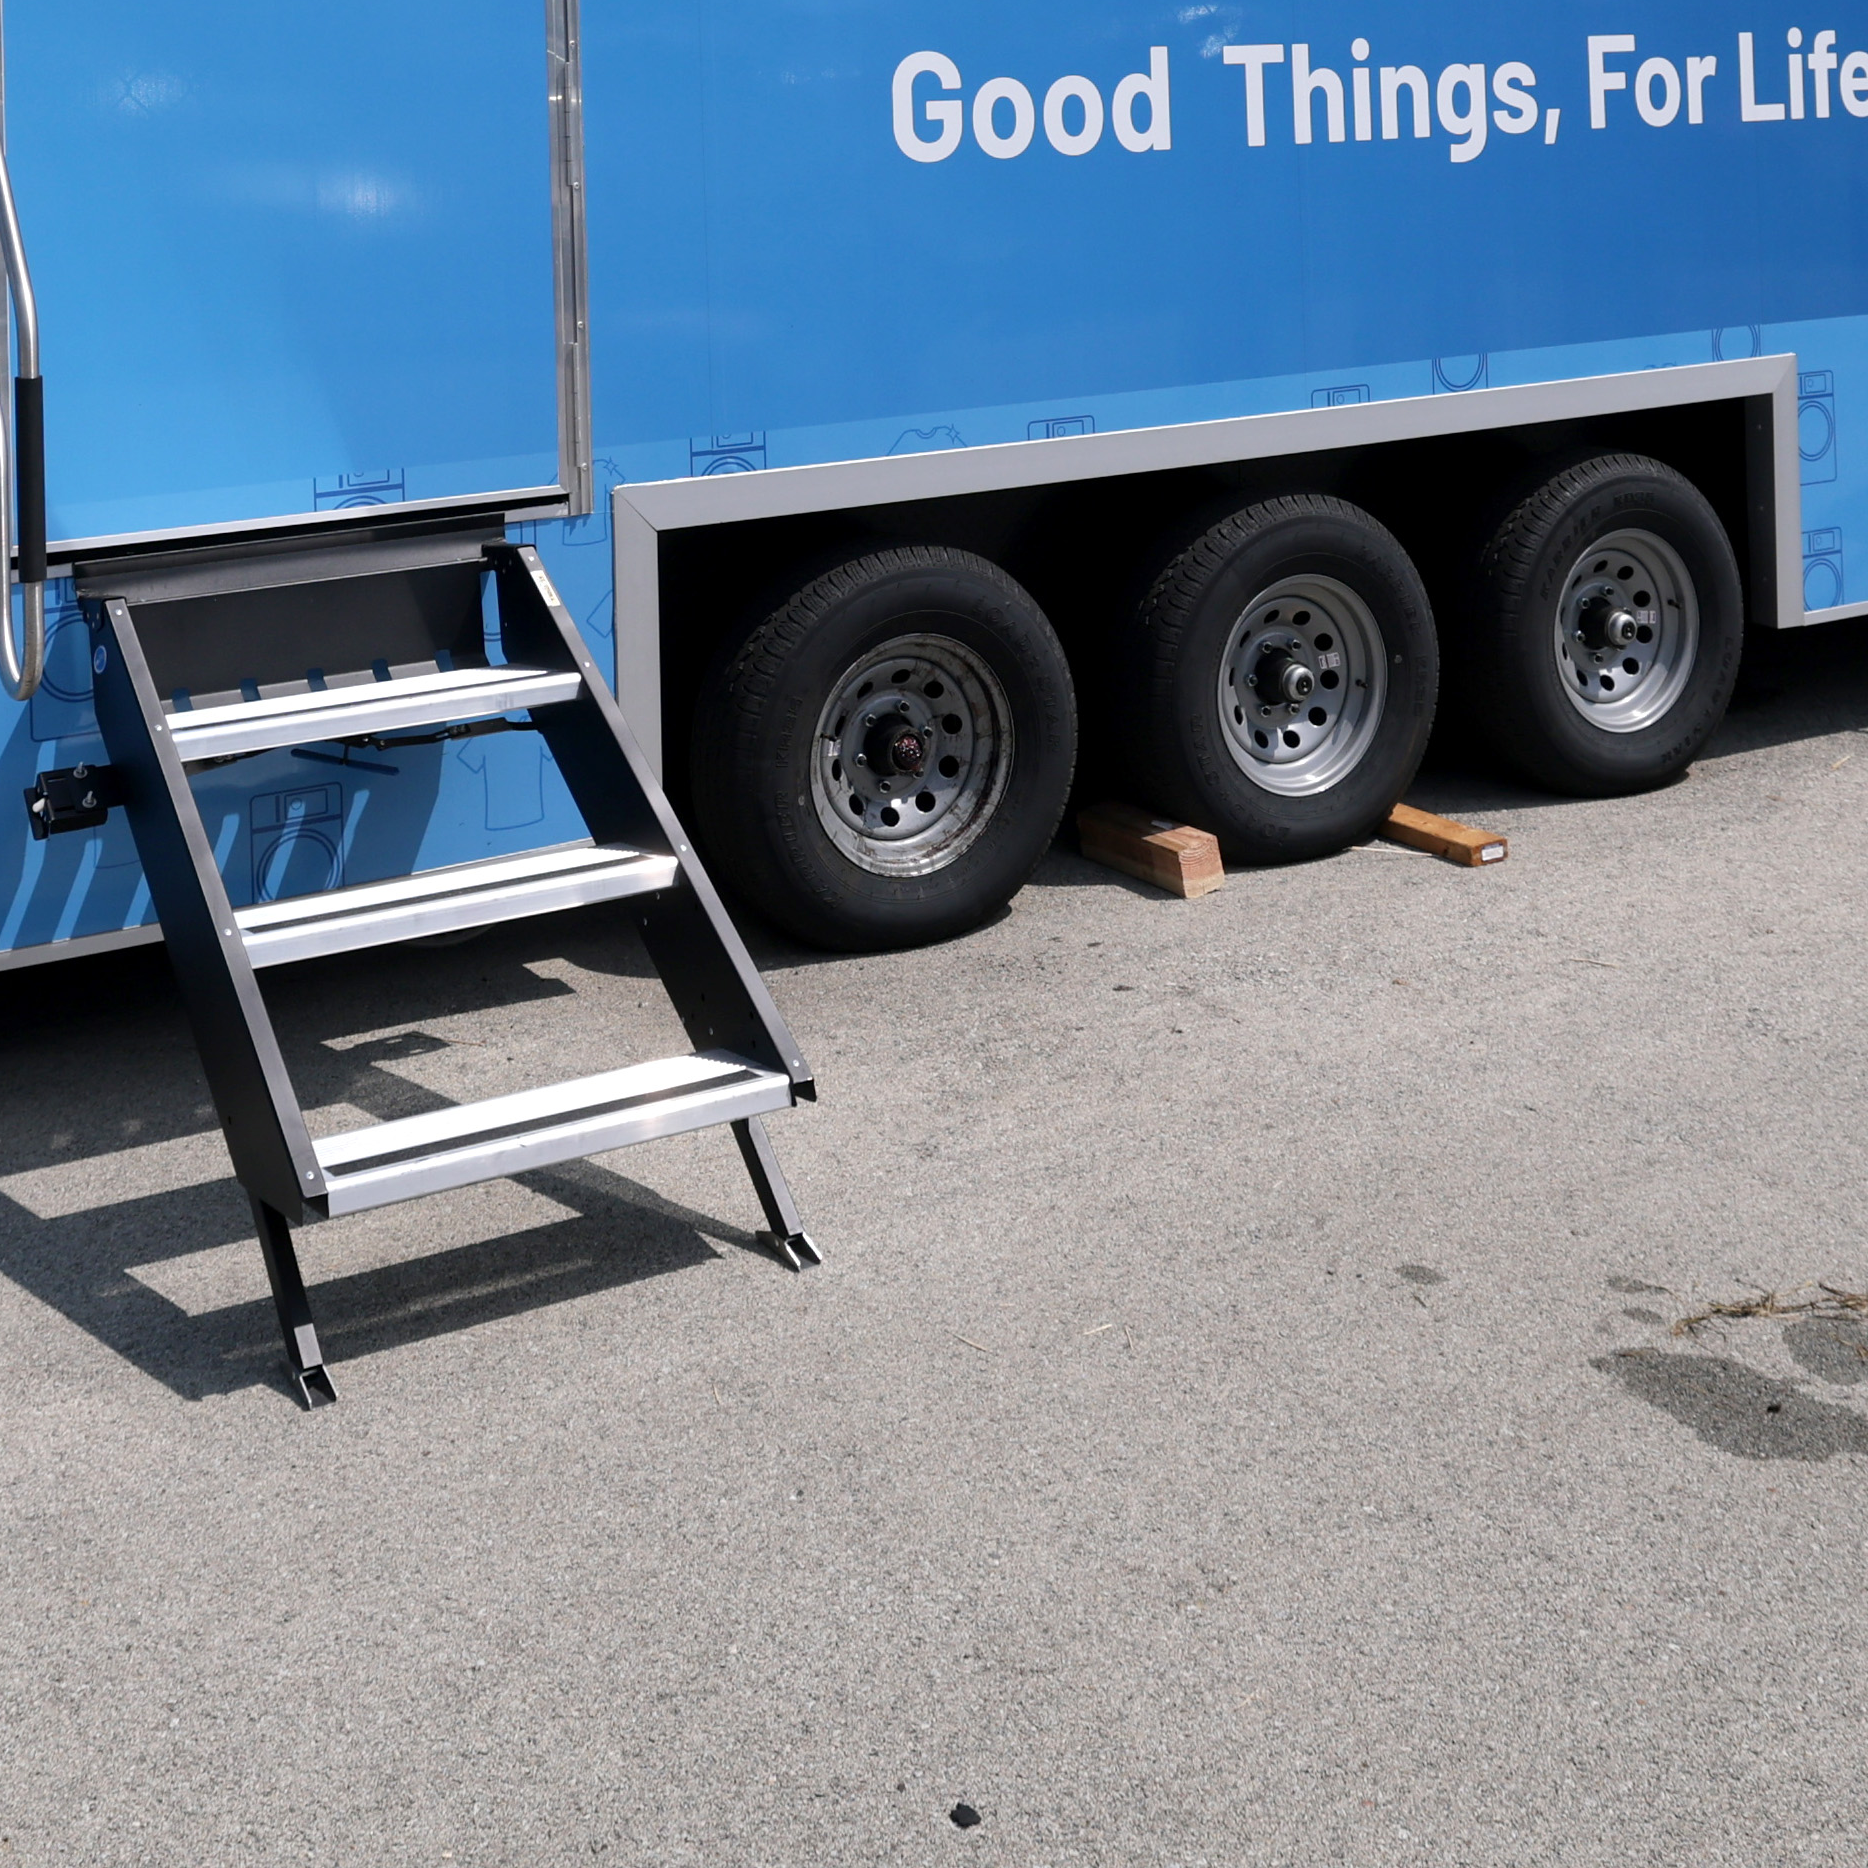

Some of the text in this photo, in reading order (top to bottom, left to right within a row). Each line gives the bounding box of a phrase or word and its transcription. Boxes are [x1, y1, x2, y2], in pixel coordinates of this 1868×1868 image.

[892, 45, 1172, 163] Good
[1222, 37, 1561, 164] Things,
[1587, 34, 1717, 129] For
